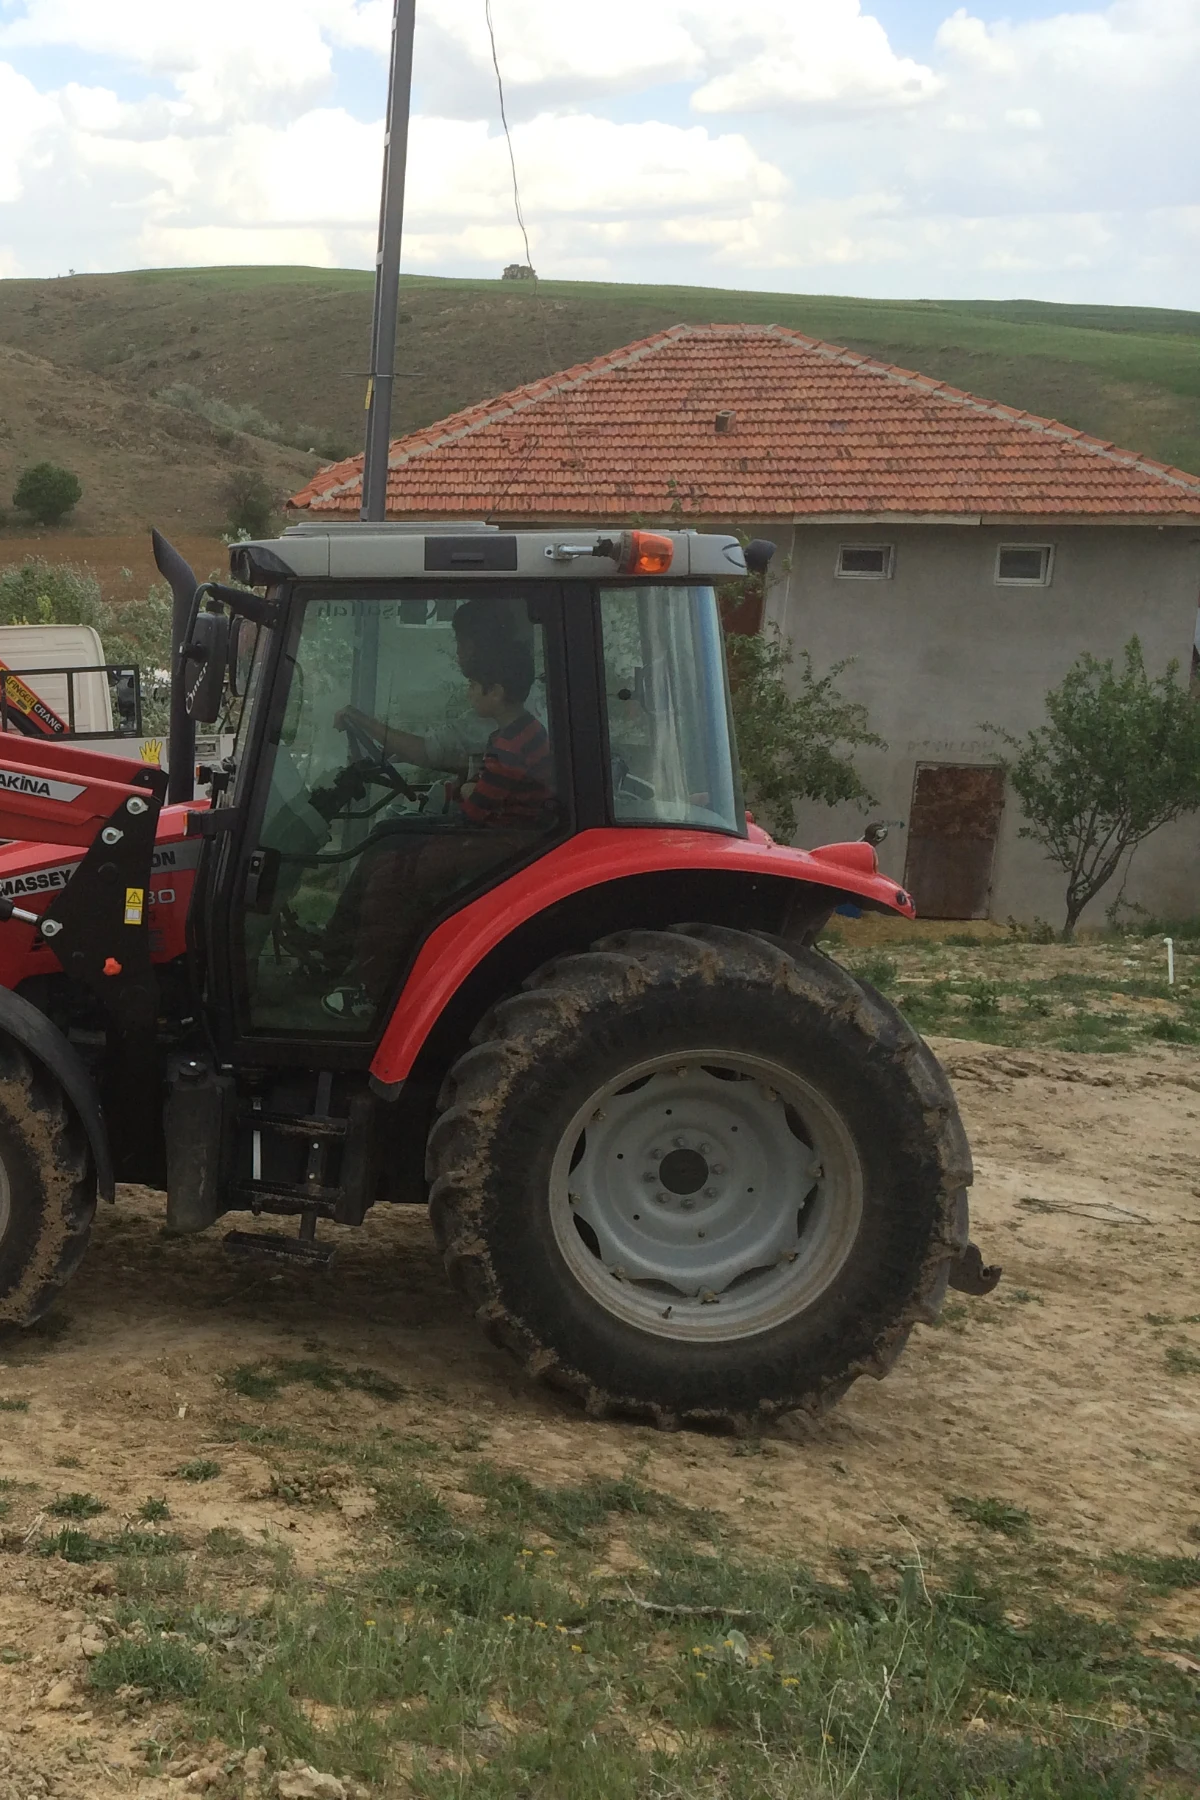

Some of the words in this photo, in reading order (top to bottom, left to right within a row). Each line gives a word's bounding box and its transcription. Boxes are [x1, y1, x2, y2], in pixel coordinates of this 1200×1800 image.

[6, 676, 36, 706] LFINGER
[33, 704, 62, 732] CRANE
[0, 869, 73, 898] MASSEY
